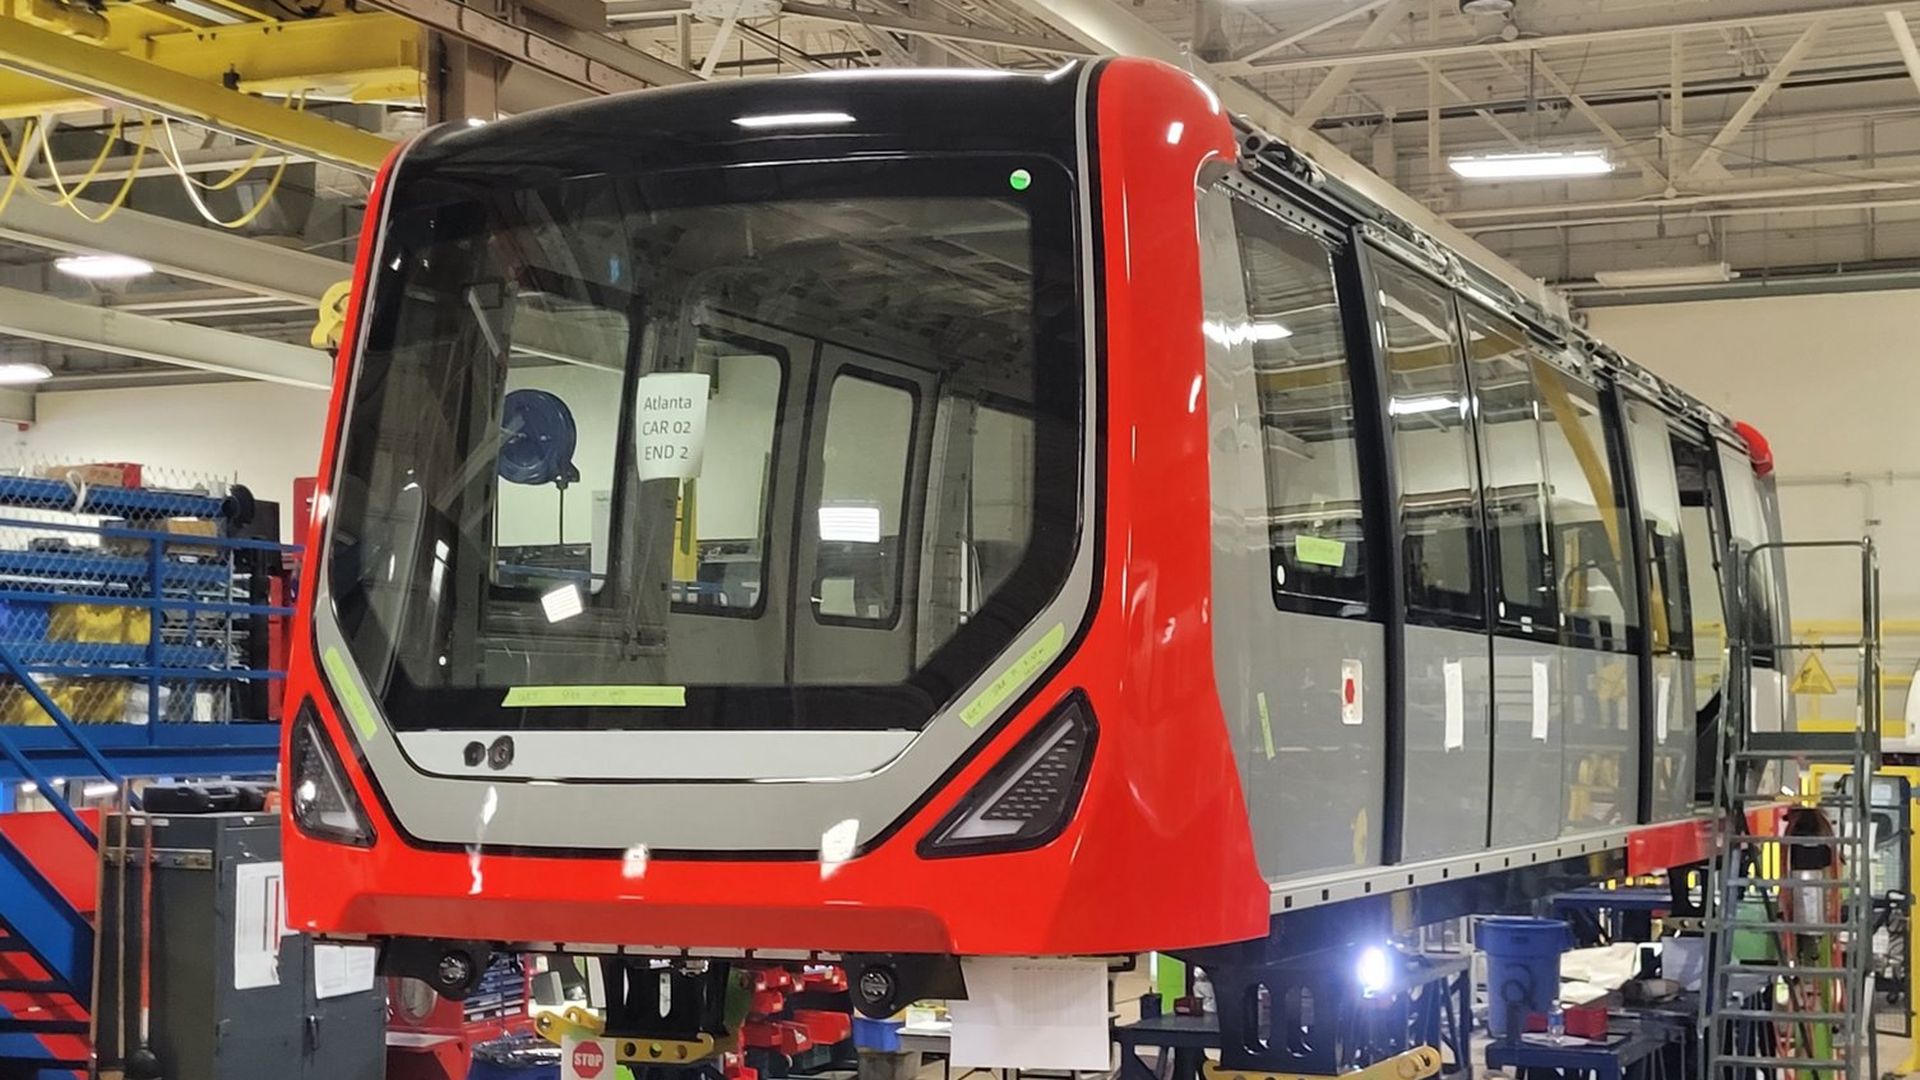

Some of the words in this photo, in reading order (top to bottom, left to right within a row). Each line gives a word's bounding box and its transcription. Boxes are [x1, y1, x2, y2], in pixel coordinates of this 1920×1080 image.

[643, 396, 692, 411] Atlanta
[642, 420, 669, 436] CAR
[673, 421, 691, 434] 02
[644, 445, 675, 460] END
[679, 446, 689, 459] 2
[574, 1052, 603, 1067] STOP
